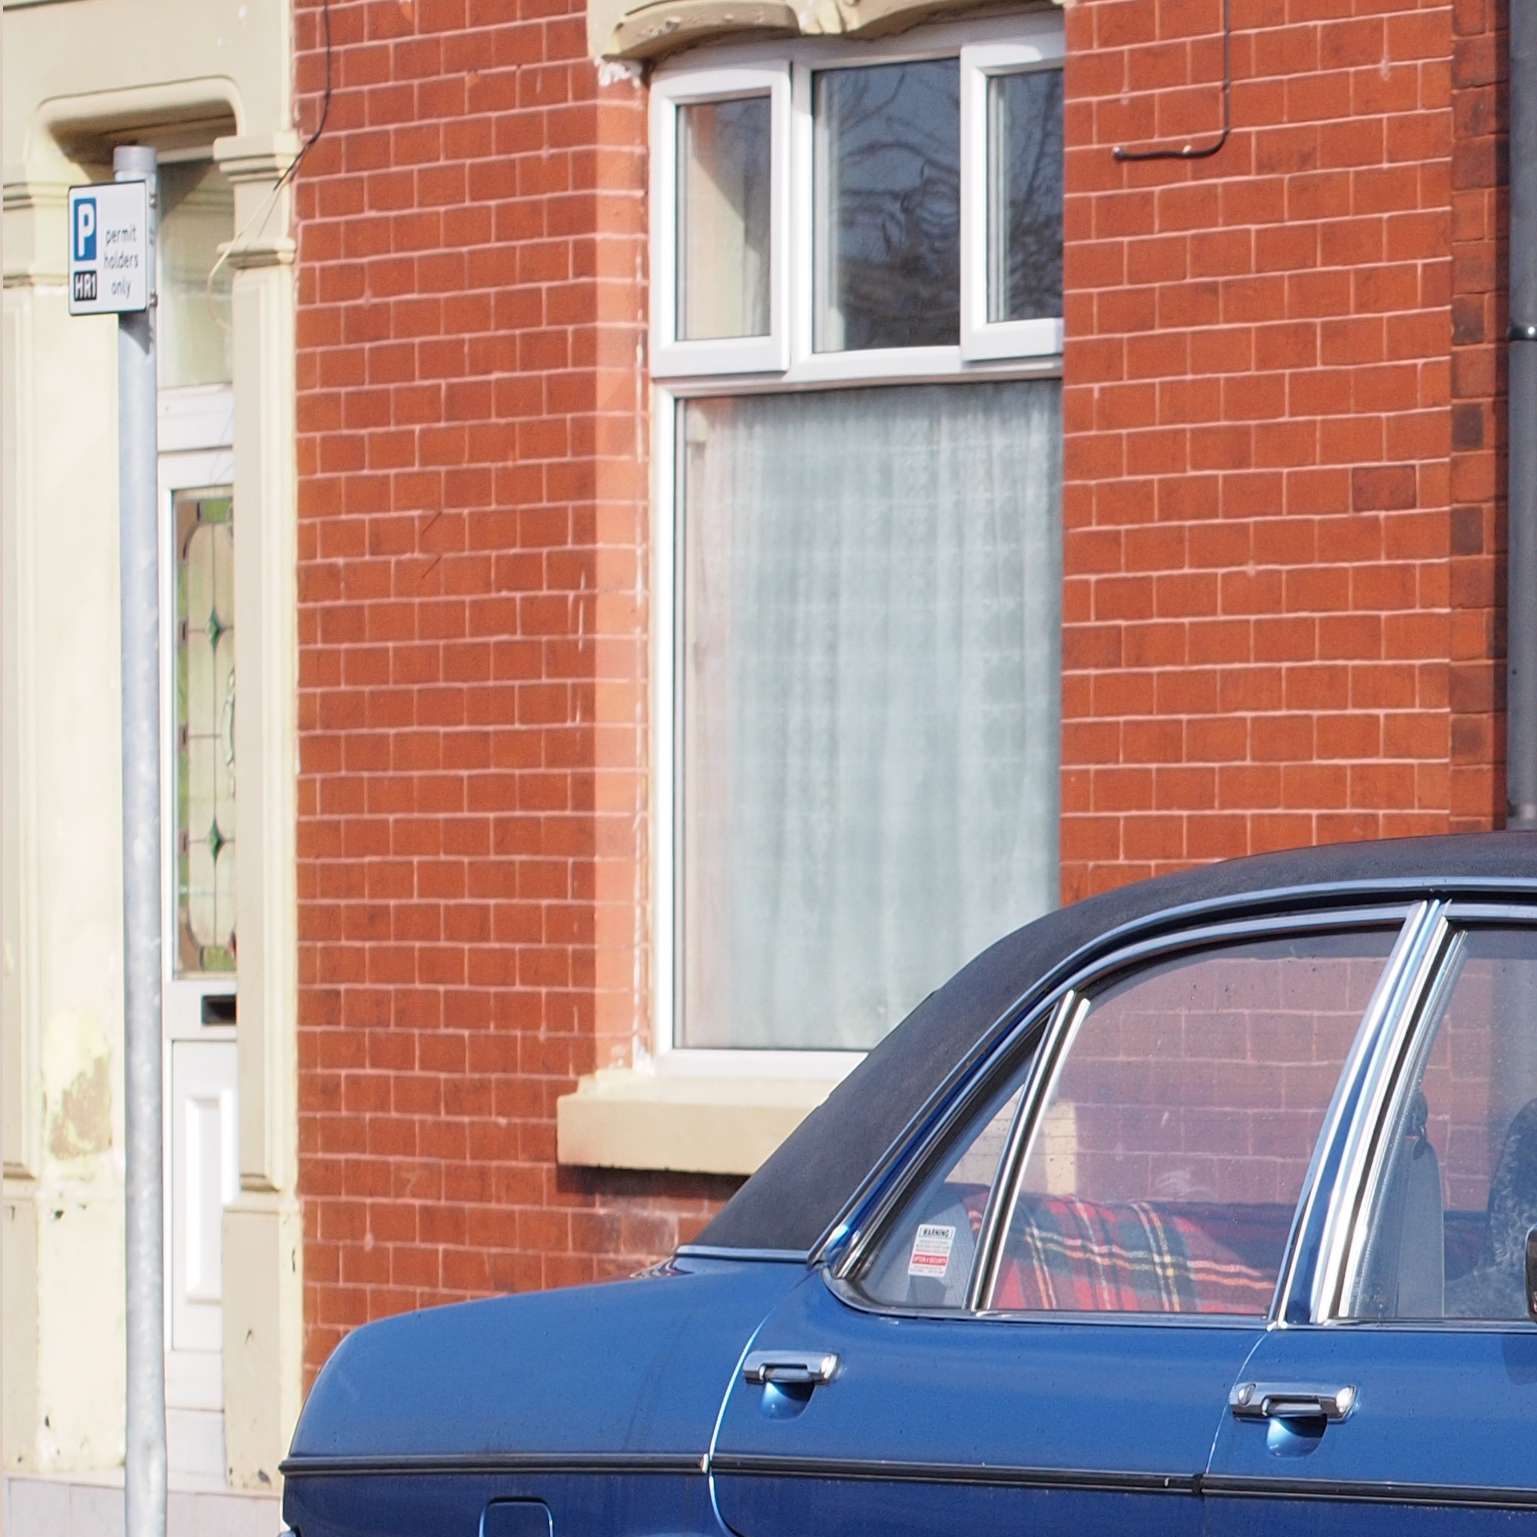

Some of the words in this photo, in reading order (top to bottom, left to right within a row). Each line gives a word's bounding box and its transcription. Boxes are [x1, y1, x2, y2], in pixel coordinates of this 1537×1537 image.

[77, 203, 95, 257] P
[105, 223, 137, 246] permit
[103, 252, 139, 270] holders
[75, 272, 97, 299] HR1
[110, 277, 131, 299] only
